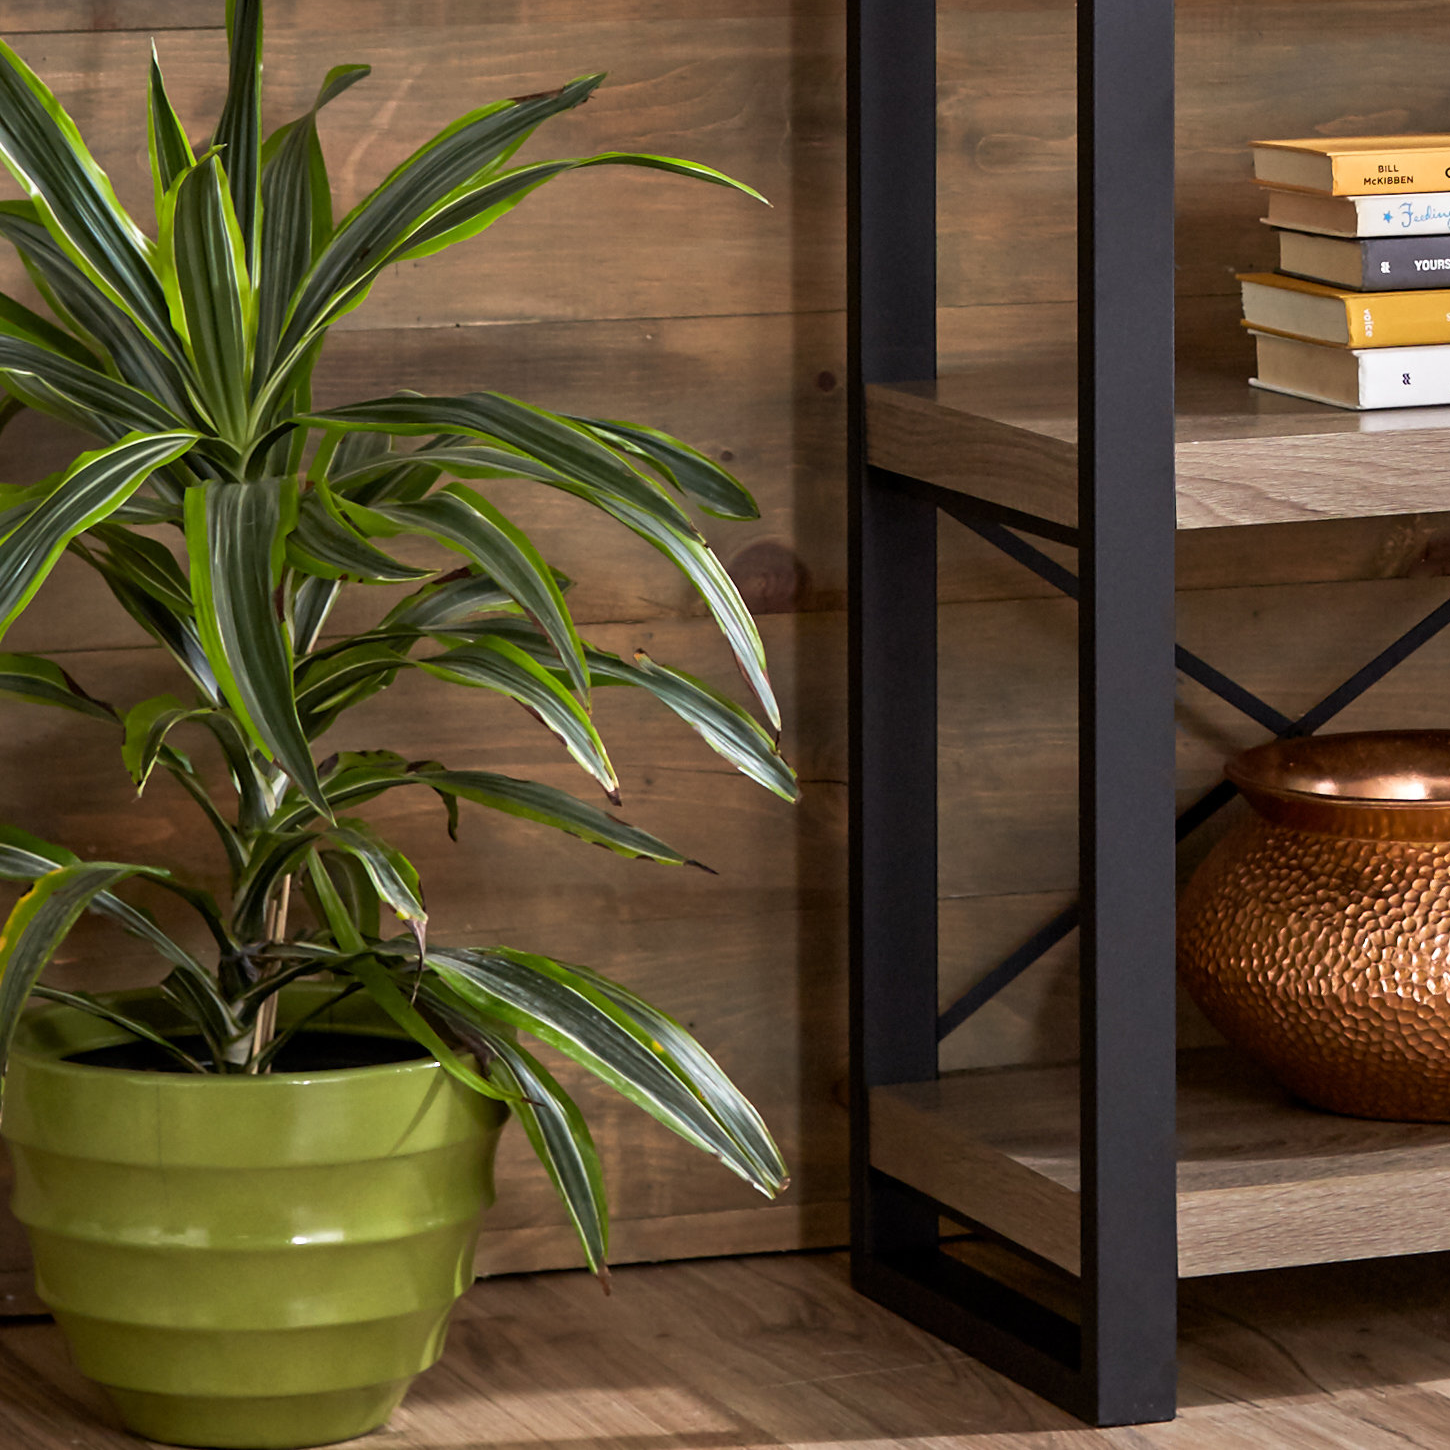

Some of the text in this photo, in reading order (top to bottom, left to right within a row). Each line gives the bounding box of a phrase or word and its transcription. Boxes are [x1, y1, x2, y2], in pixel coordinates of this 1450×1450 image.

[1378, 165, 1399, 173] BILL
[1363, 176, 1414, 186] McKIBBEN
[1363, 308, 1374, 338] voice
